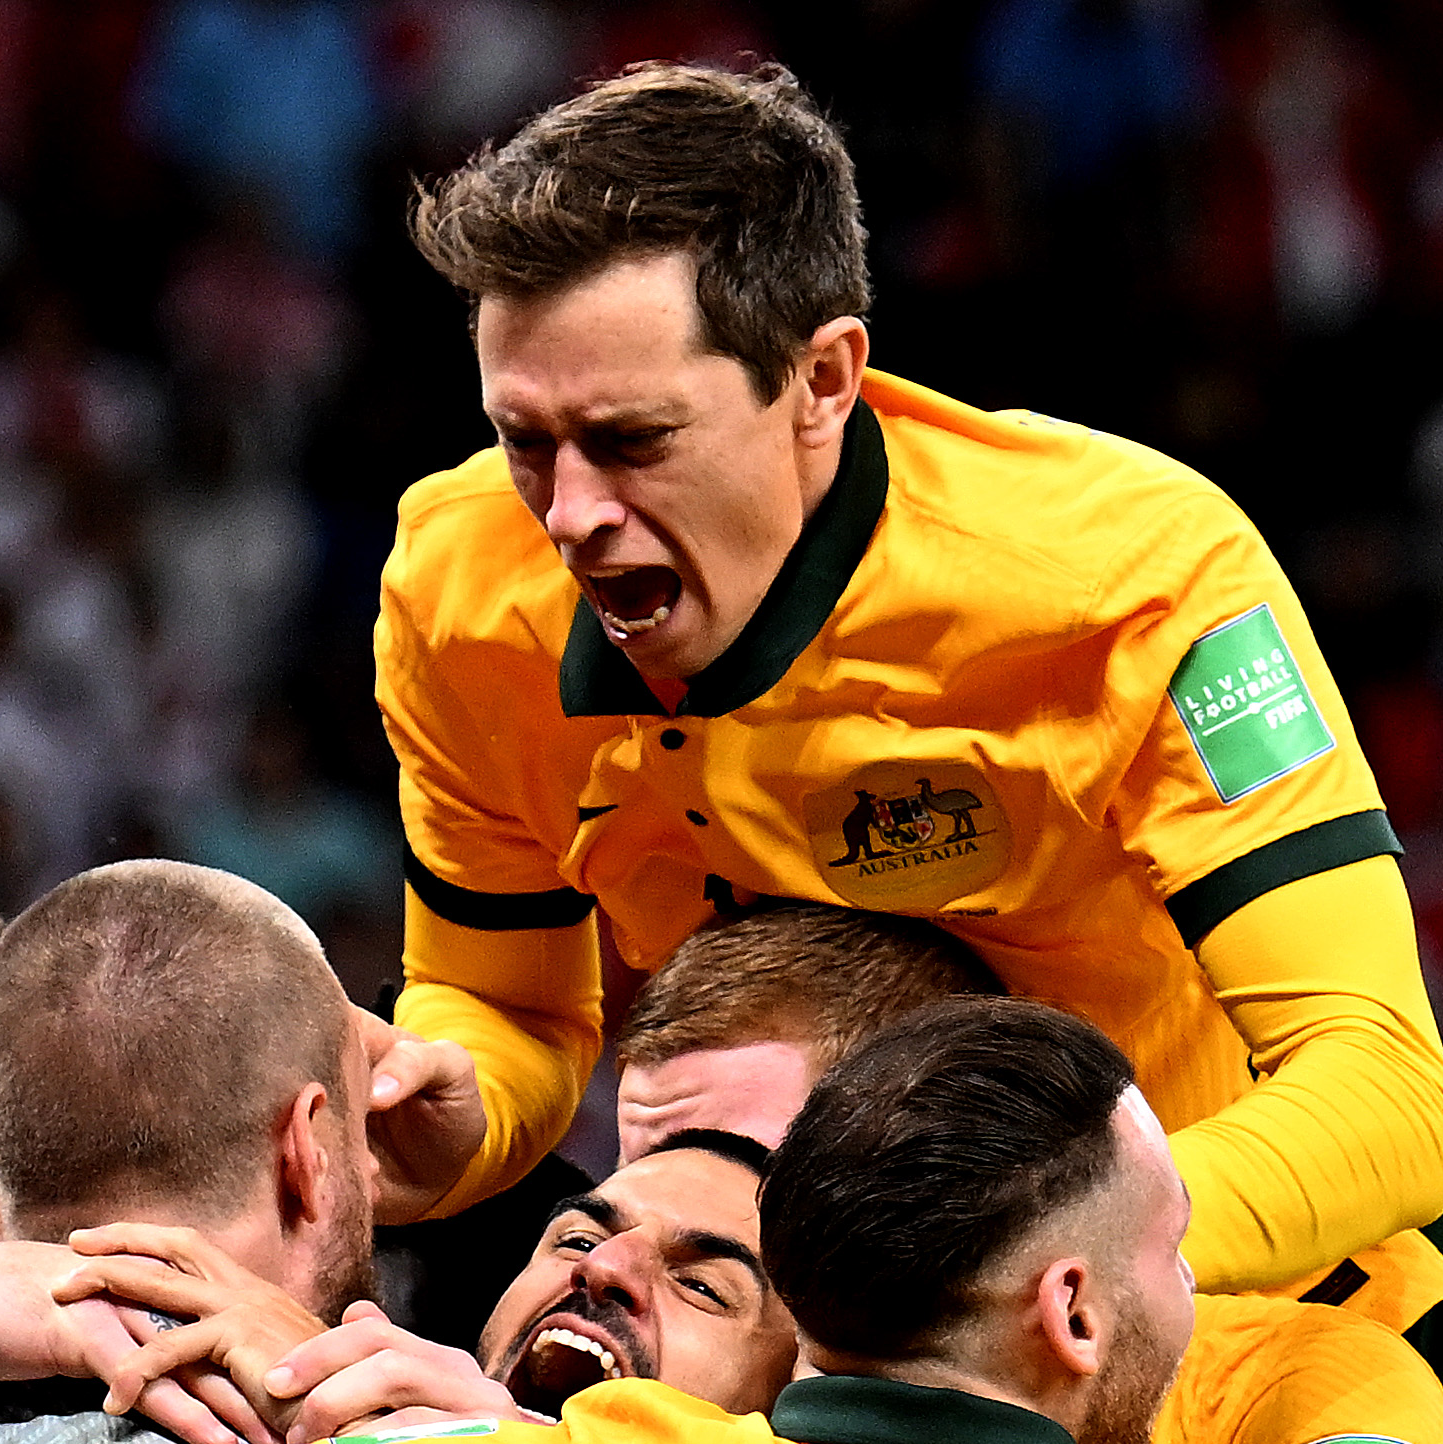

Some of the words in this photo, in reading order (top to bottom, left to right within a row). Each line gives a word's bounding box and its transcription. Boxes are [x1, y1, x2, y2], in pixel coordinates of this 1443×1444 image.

[1185, 648, 1285, 711] LIVING
[1193, 666, 1293, 726] FOOTBALL
[1265, 694, 1308, 730] FIFA
[858, 841, 979, 877] AUSTRALIA
